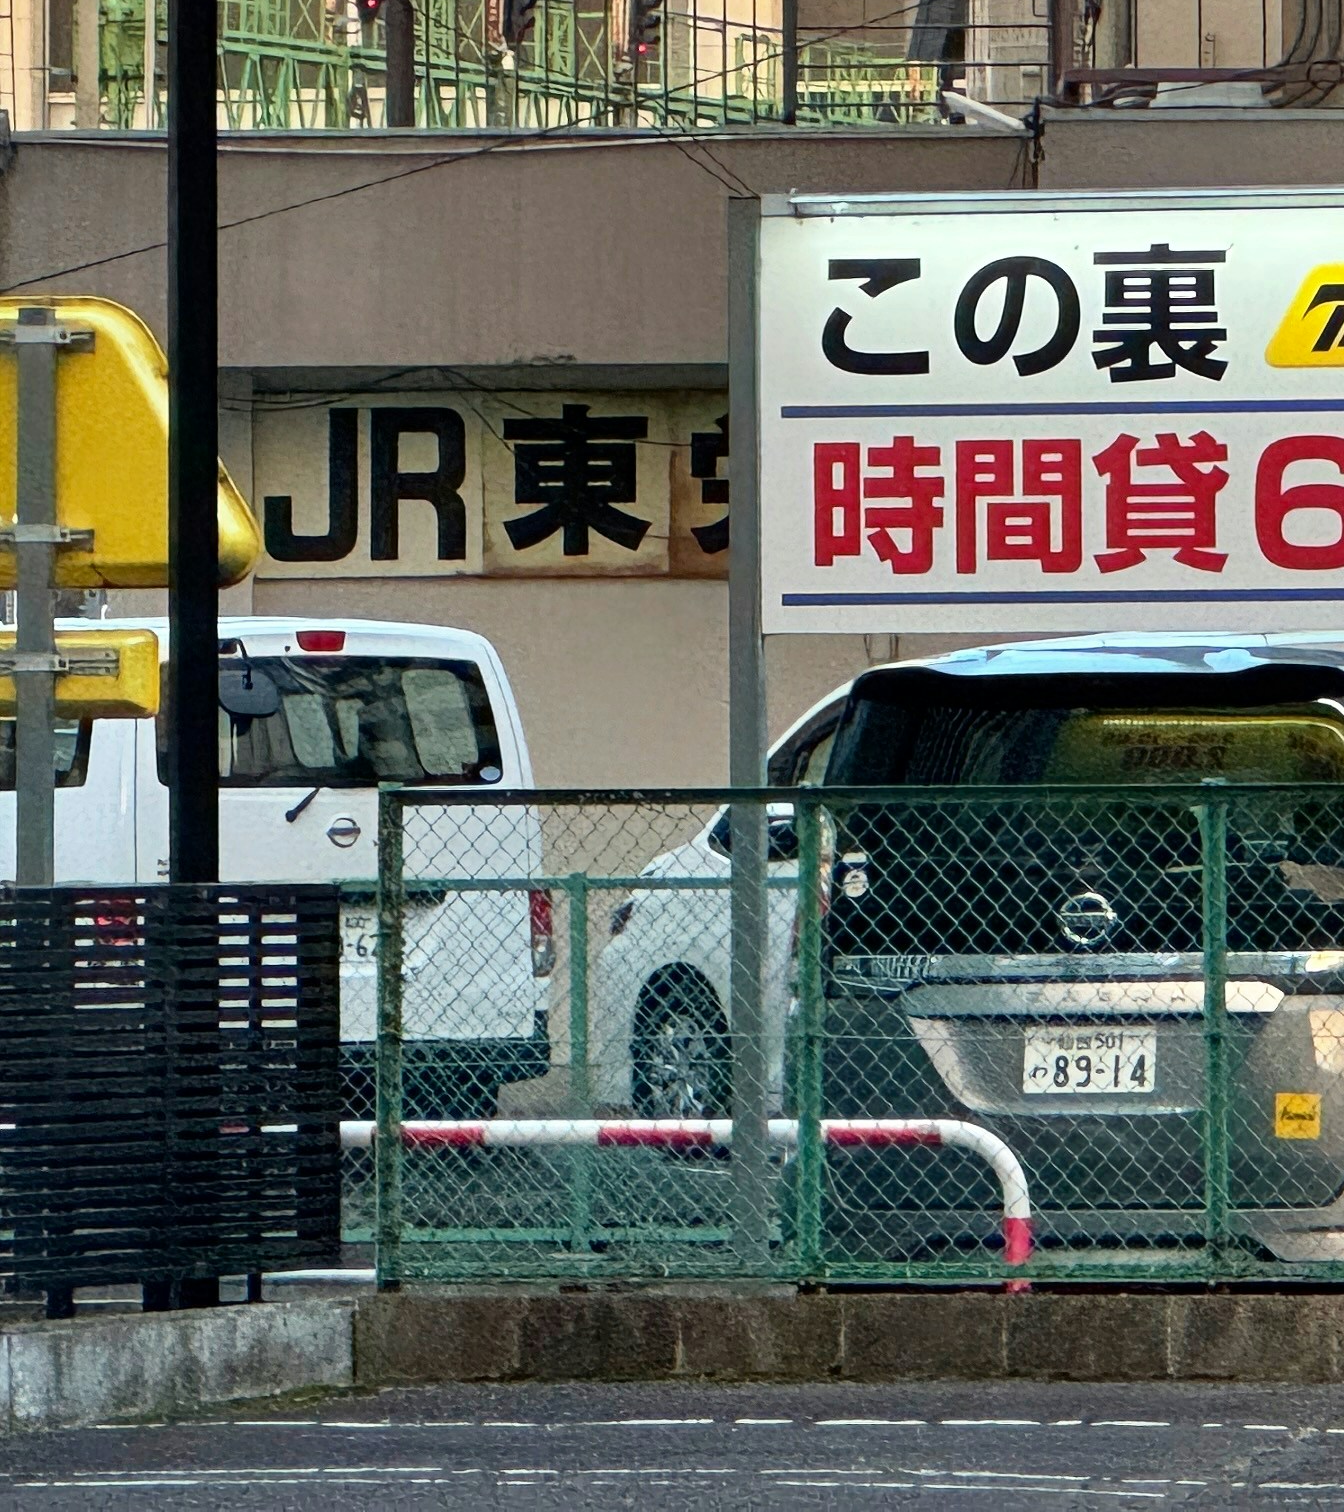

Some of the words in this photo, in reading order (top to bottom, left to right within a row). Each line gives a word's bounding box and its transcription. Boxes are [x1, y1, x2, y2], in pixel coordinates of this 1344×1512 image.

[821, 242, 1230, 383] この裏
[264, 402, 729, 563] JR東
[1053, 1054, 1147, 1088] 89-14
